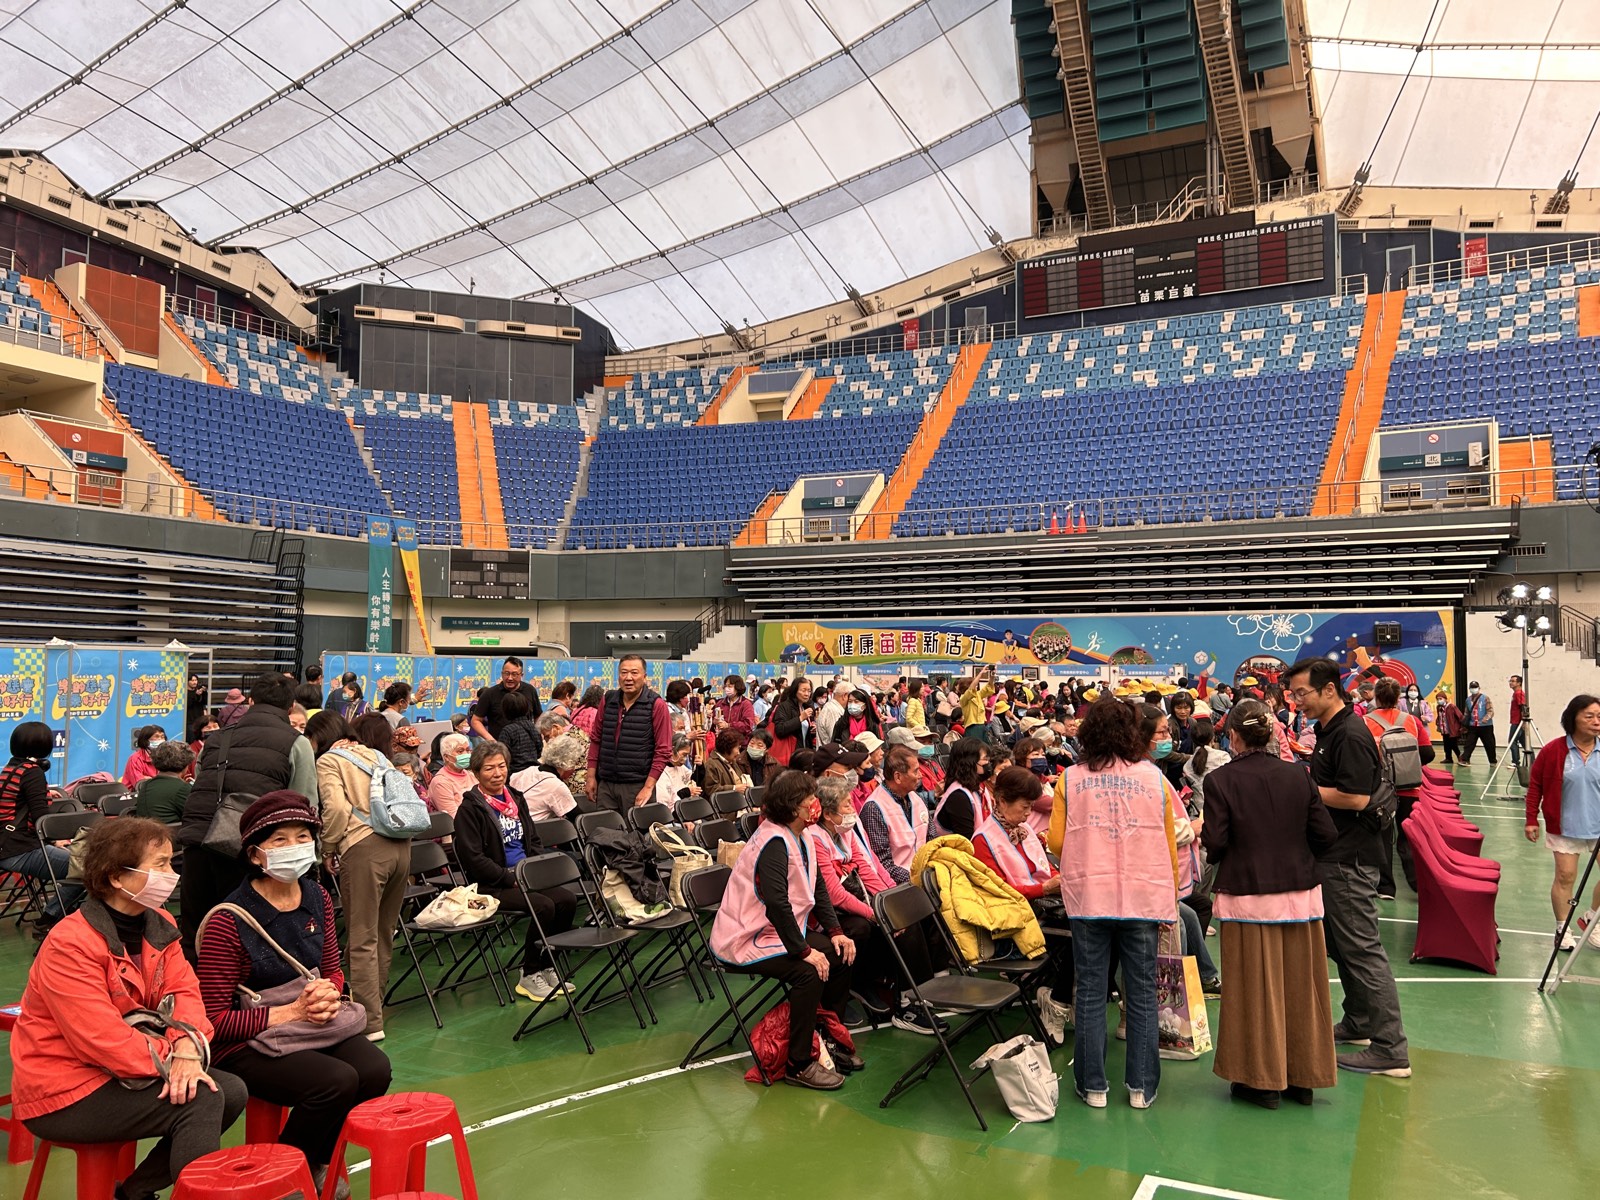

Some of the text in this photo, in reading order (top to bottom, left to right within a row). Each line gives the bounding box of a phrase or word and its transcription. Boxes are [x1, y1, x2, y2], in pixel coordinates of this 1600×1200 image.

[1139, 286, 1194, 303] 苗栗巨蛋
[382, 567, 391, 627] 人生轉彎處
[838, 630, 987, 660] 健康苗栗新活力
[0, 694, 34, 708] 好行
